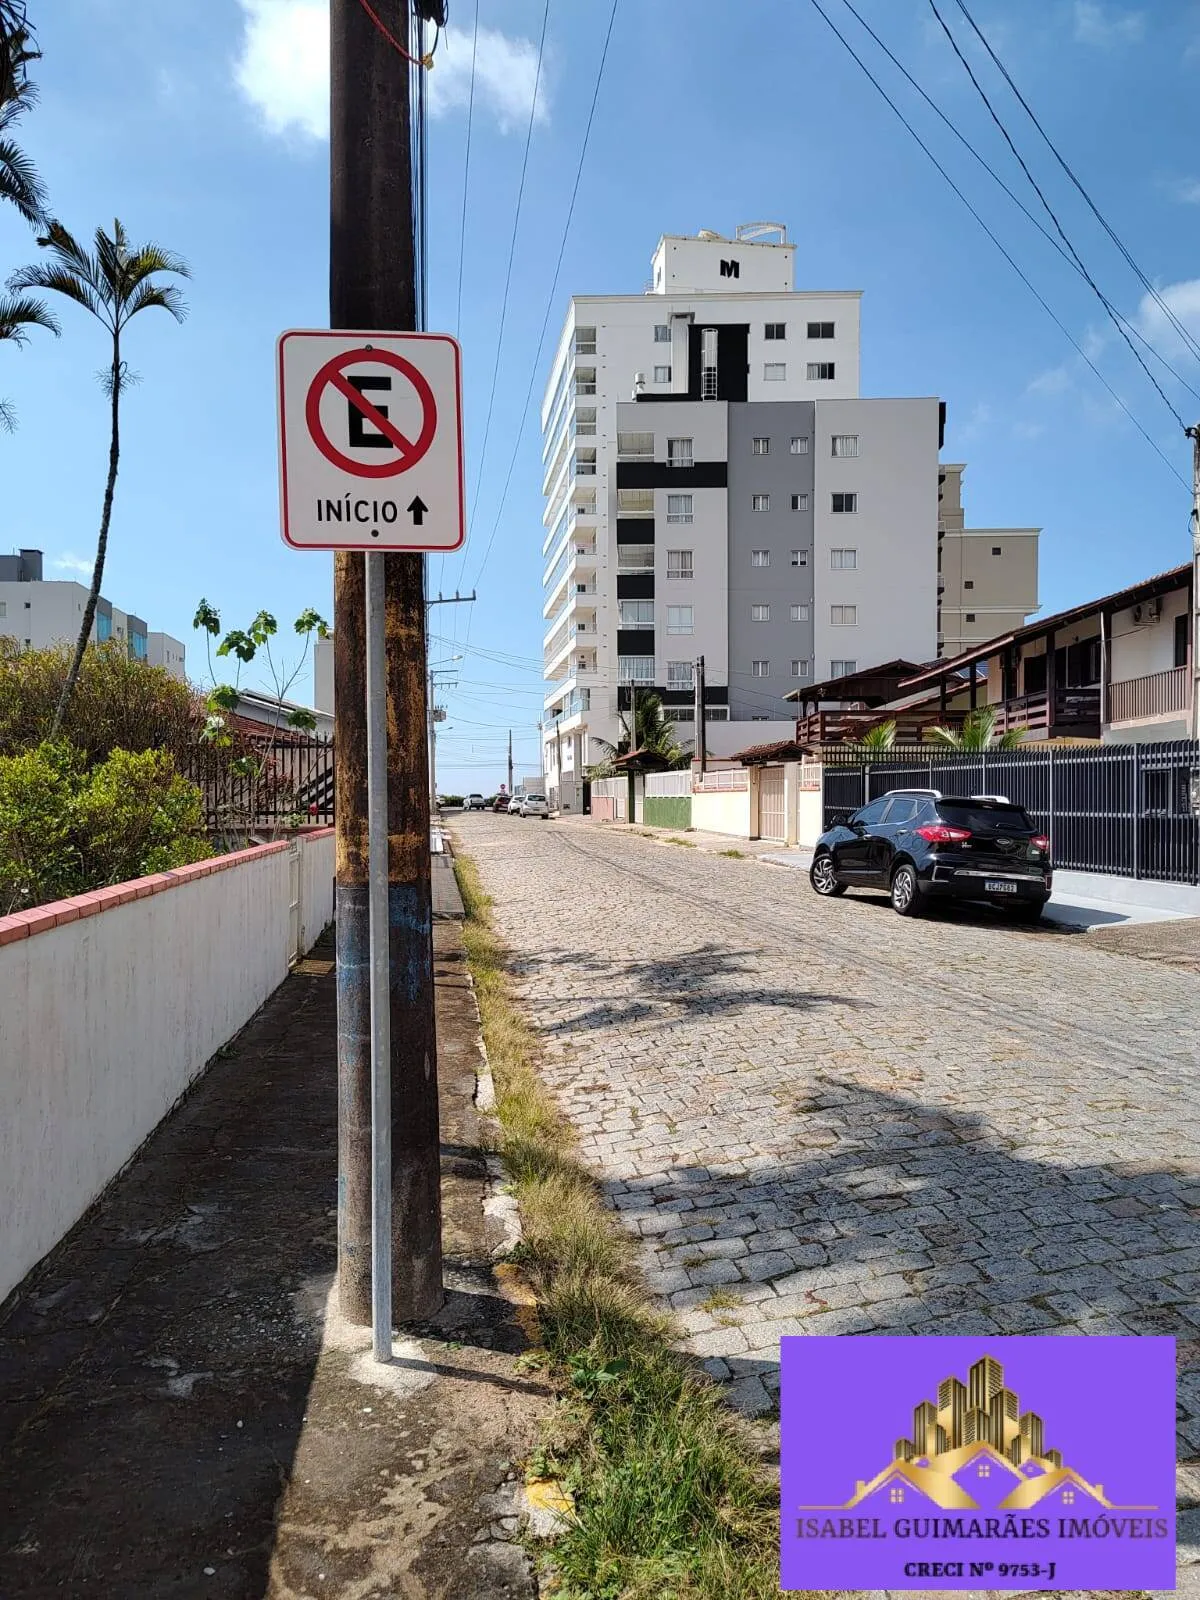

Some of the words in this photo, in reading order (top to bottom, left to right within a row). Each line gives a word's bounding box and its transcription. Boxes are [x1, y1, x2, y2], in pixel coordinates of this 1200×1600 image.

[720, 259, 740, 279] M
[347, 375, 393, 448] E
[316, 492, 398, 523] INÍCIO
